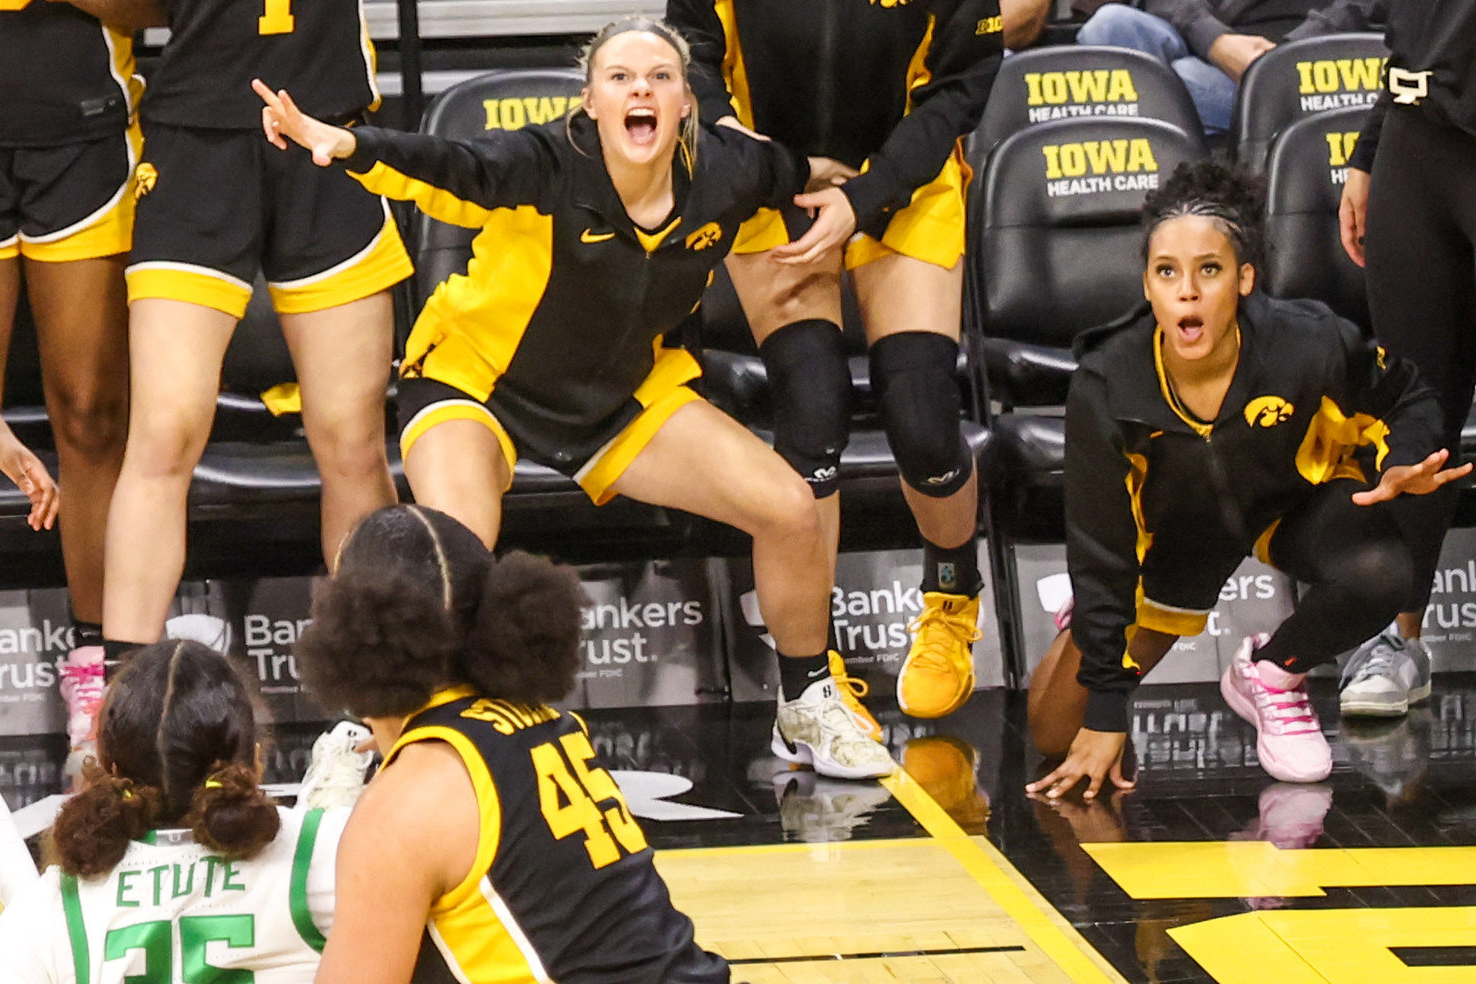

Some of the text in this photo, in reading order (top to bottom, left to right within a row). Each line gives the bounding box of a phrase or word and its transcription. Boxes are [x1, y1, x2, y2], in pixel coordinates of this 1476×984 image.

[1025, 69, 1139, 106] IOWA
[1296, 57, 1389, 94] IOW
[483, 97, 583, 132] IOW
[1028, 103, 1092, 123] HEALTH
[1300, 92, 1363, 112] HEALTH
[1042, 138, 1159, 180] IOWA
[1047, 173, 1160, 198] HEALTH CARE
[831, 580, 924, 617] Bank
[529, 731, 649, 870] 45
[116, 855, 246, 908] ETUTE
